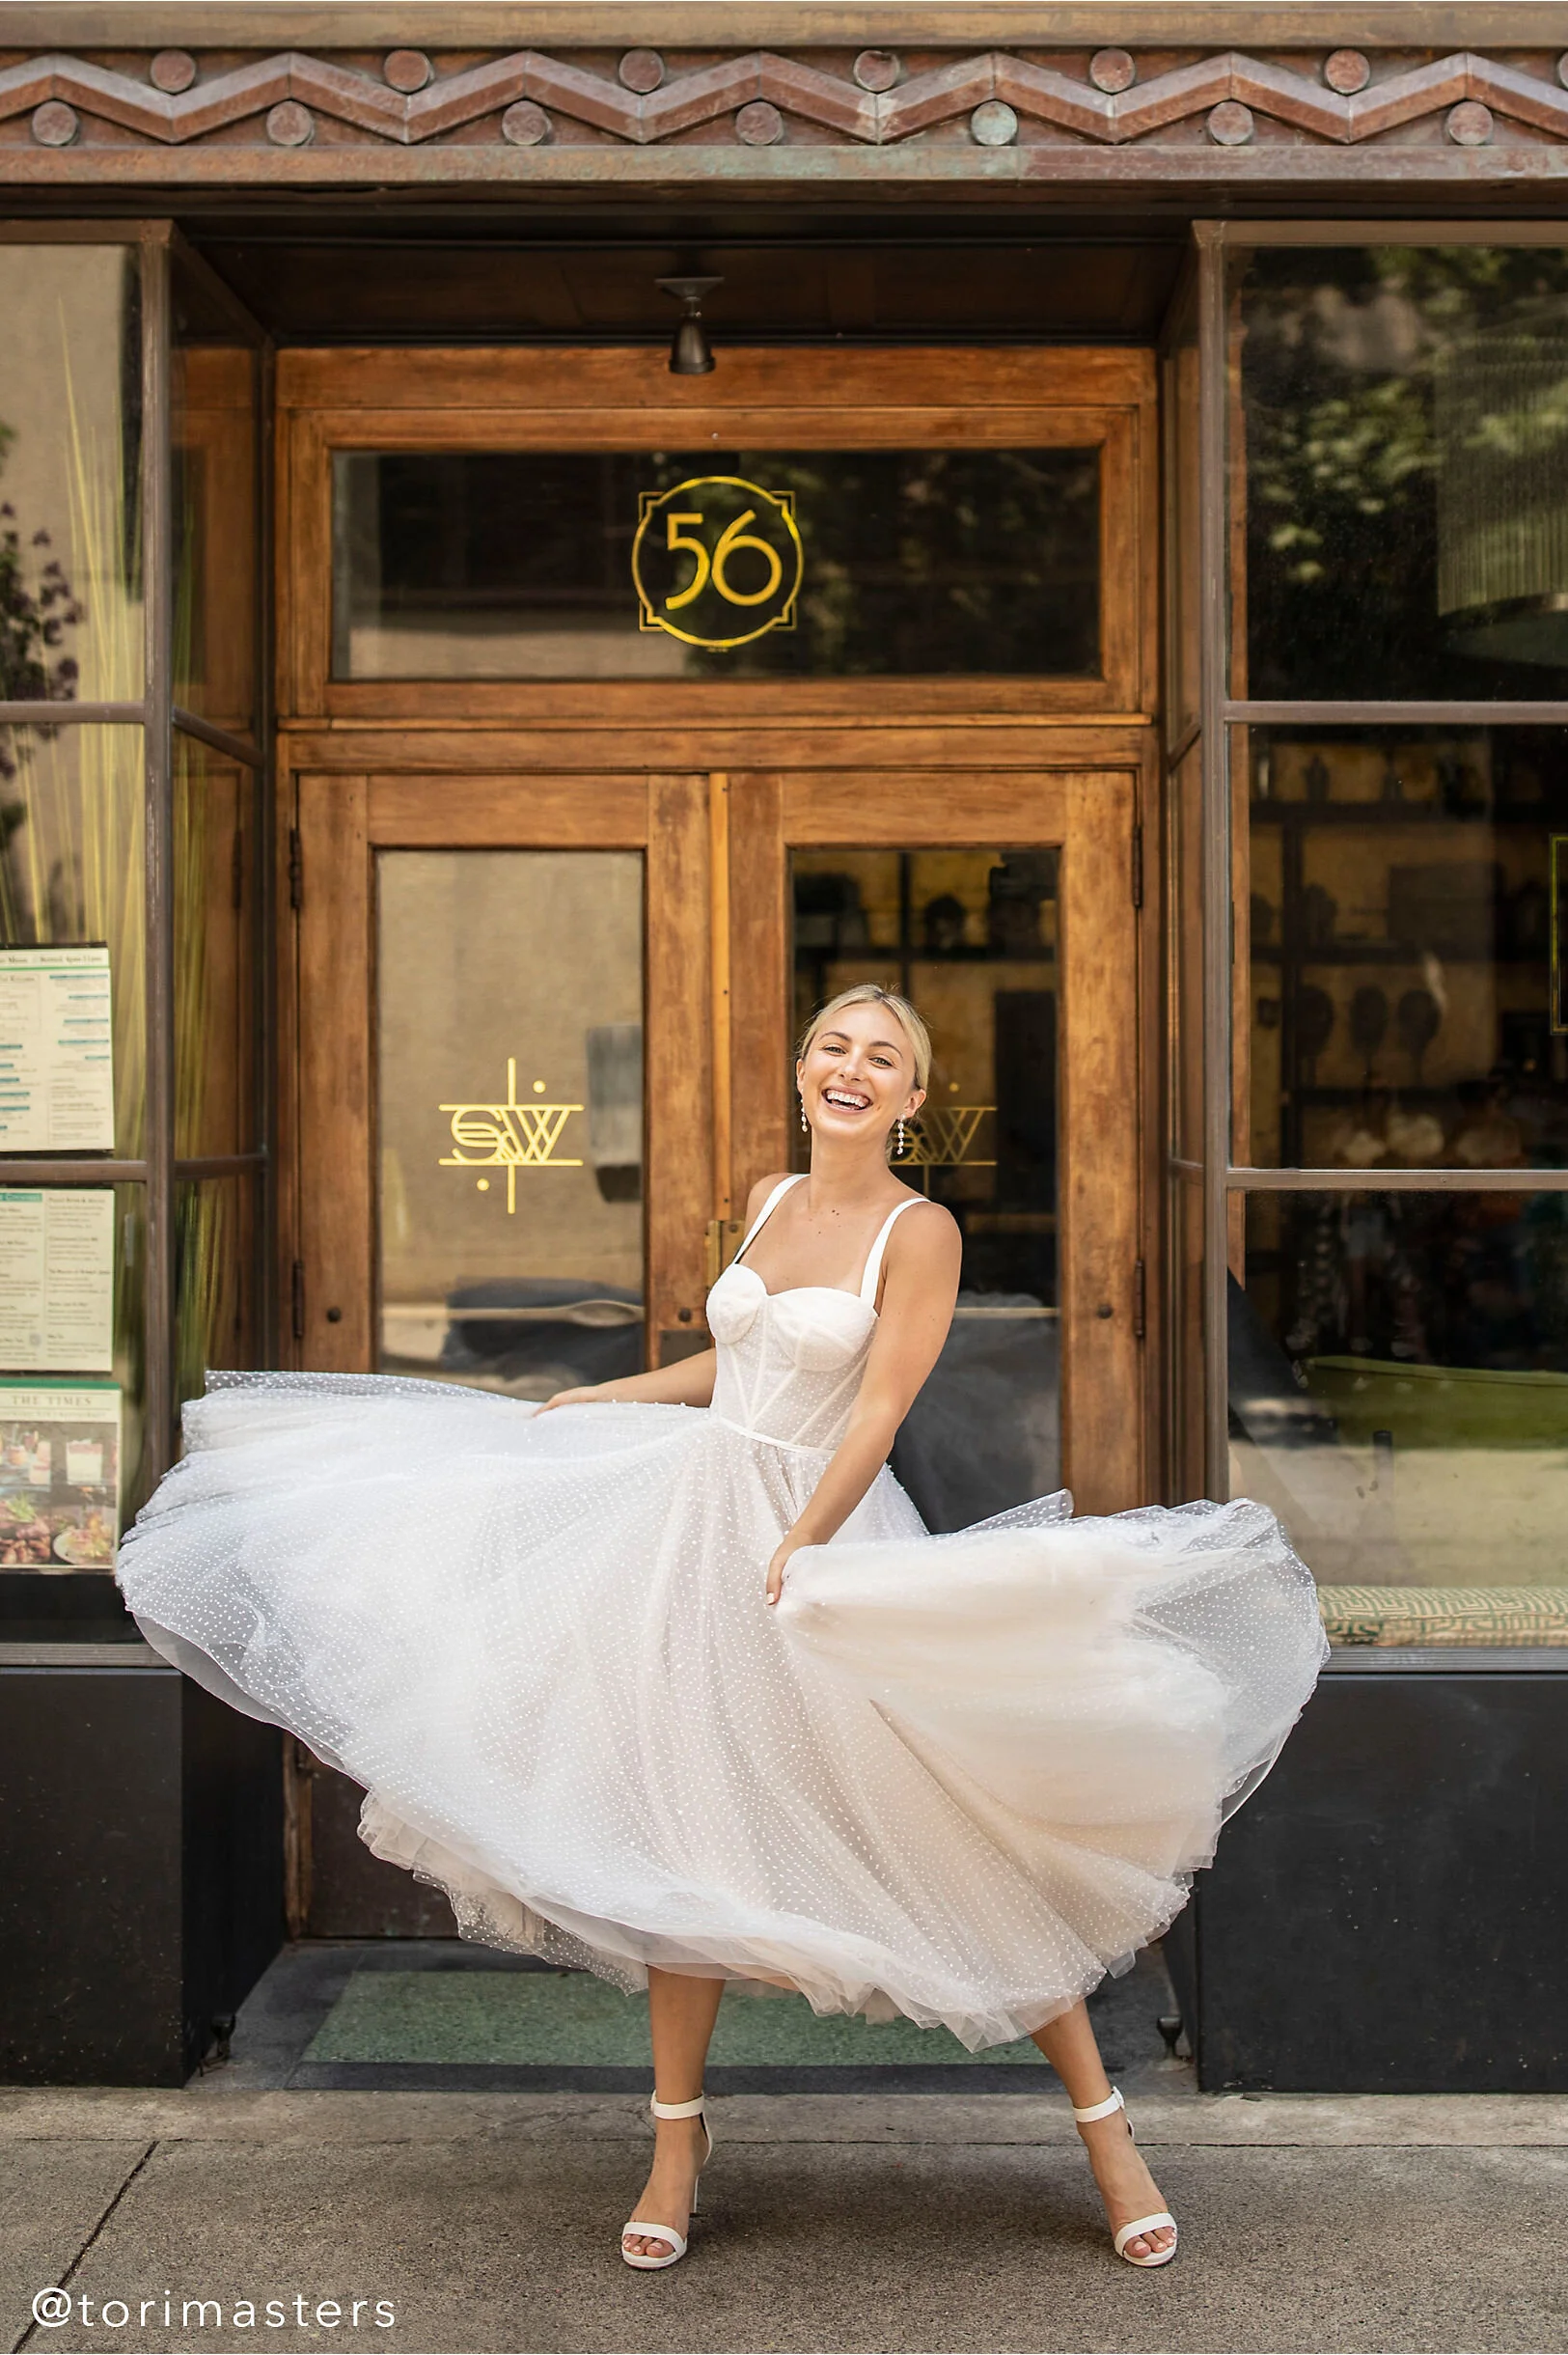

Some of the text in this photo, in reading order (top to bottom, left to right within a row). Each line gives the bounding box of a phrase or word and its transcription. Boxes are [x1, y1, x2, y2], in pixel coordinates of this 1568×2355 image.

[665, 509, 783, 610] 56
[11, 1396, 93, 1407] THE TIMES
